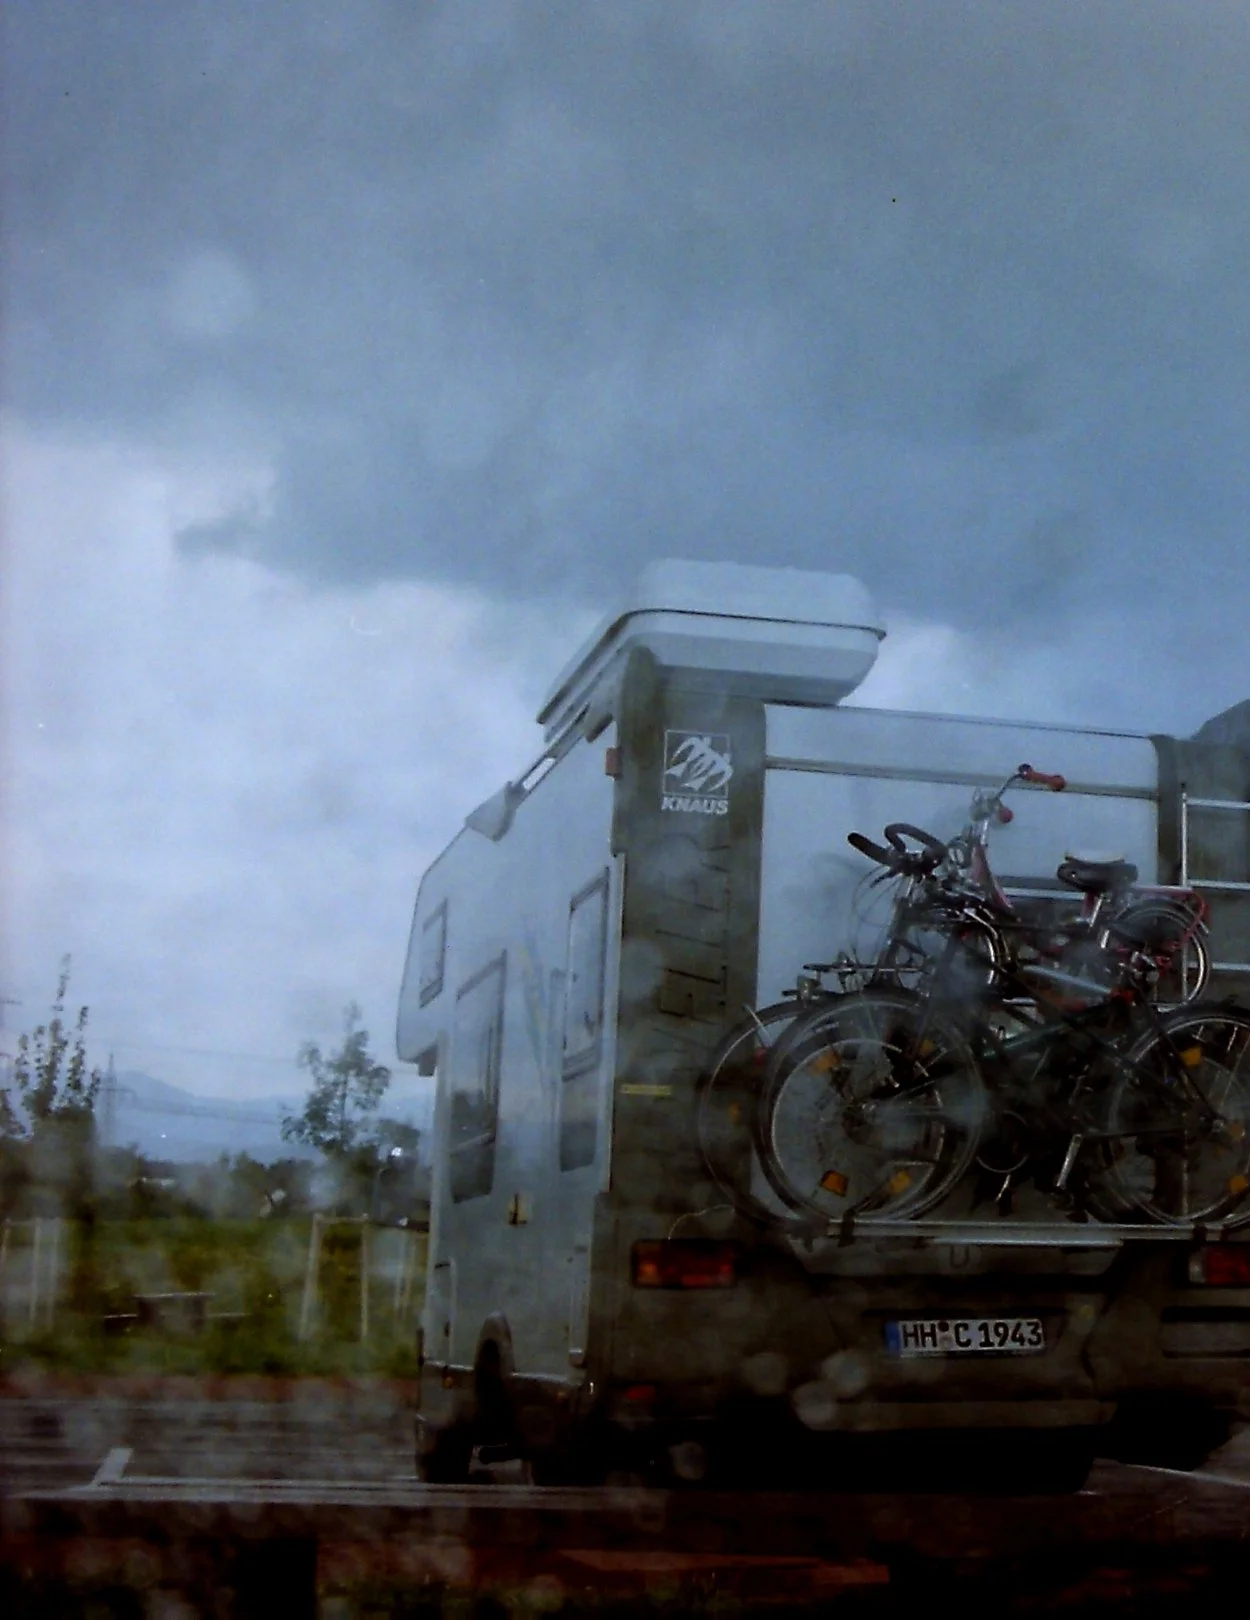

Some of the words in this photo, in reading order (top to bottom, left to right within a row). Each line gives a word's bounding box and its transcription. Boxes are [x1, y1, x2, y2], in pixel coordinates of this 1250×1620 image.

[660, 796, 728, 814] KNAUS
[902, 1323, 938, 1348] HH
[978, 1321, 1042, 1348] 1943
